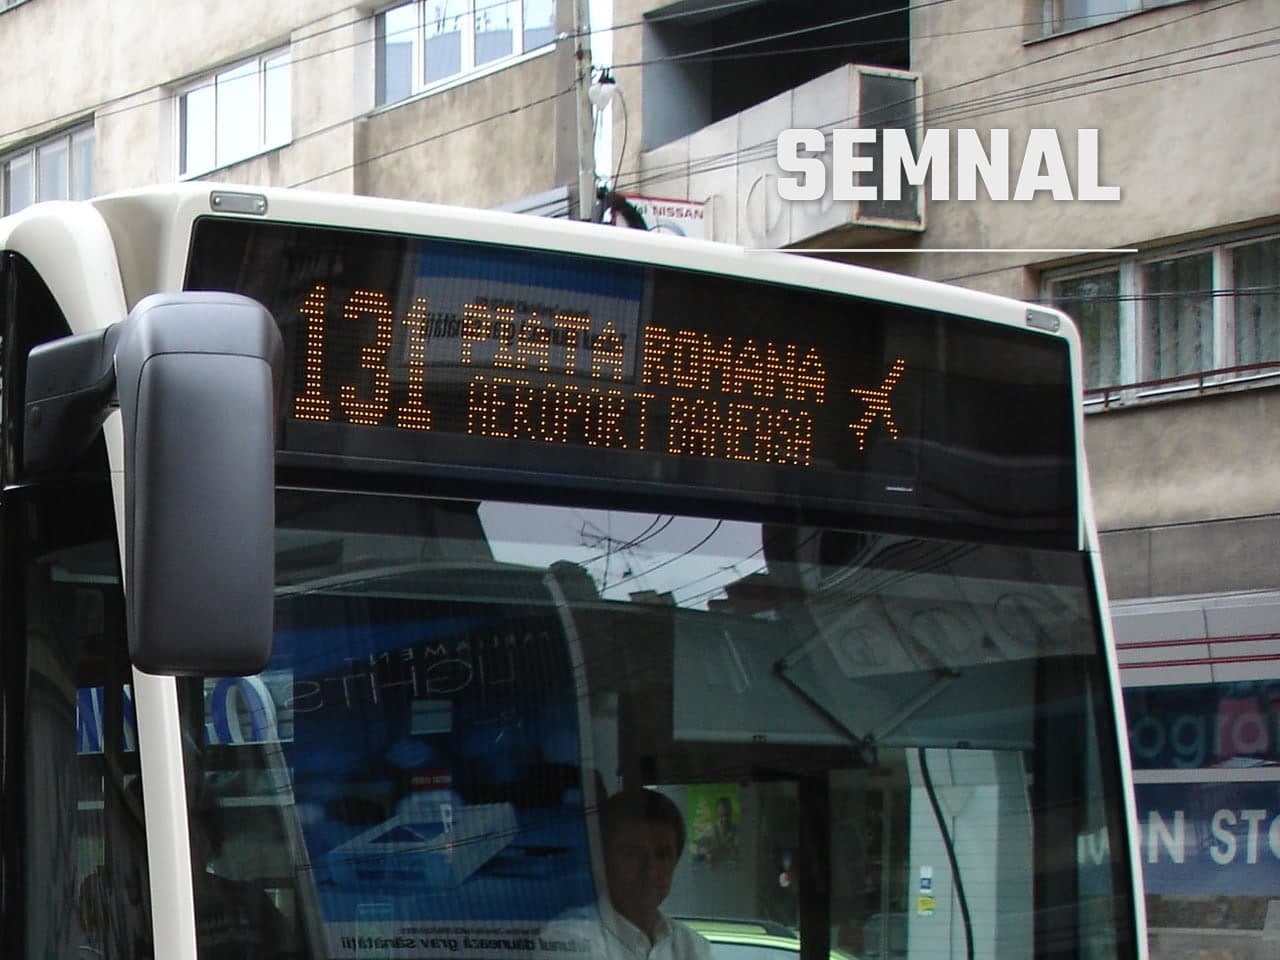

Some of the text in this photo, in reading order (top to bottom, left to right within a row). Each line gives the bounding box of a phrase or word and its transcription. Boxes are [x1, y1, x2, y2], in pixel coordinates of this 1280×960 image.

[652, 205, 703, 220] NISSAN
[294, 285, 431, 431] 131
[460, 302, 625, 381] PIATA
[642, 324, 827, 404] ROMANA
[467, 374, 814, 467] AEROPORT BANEASA
